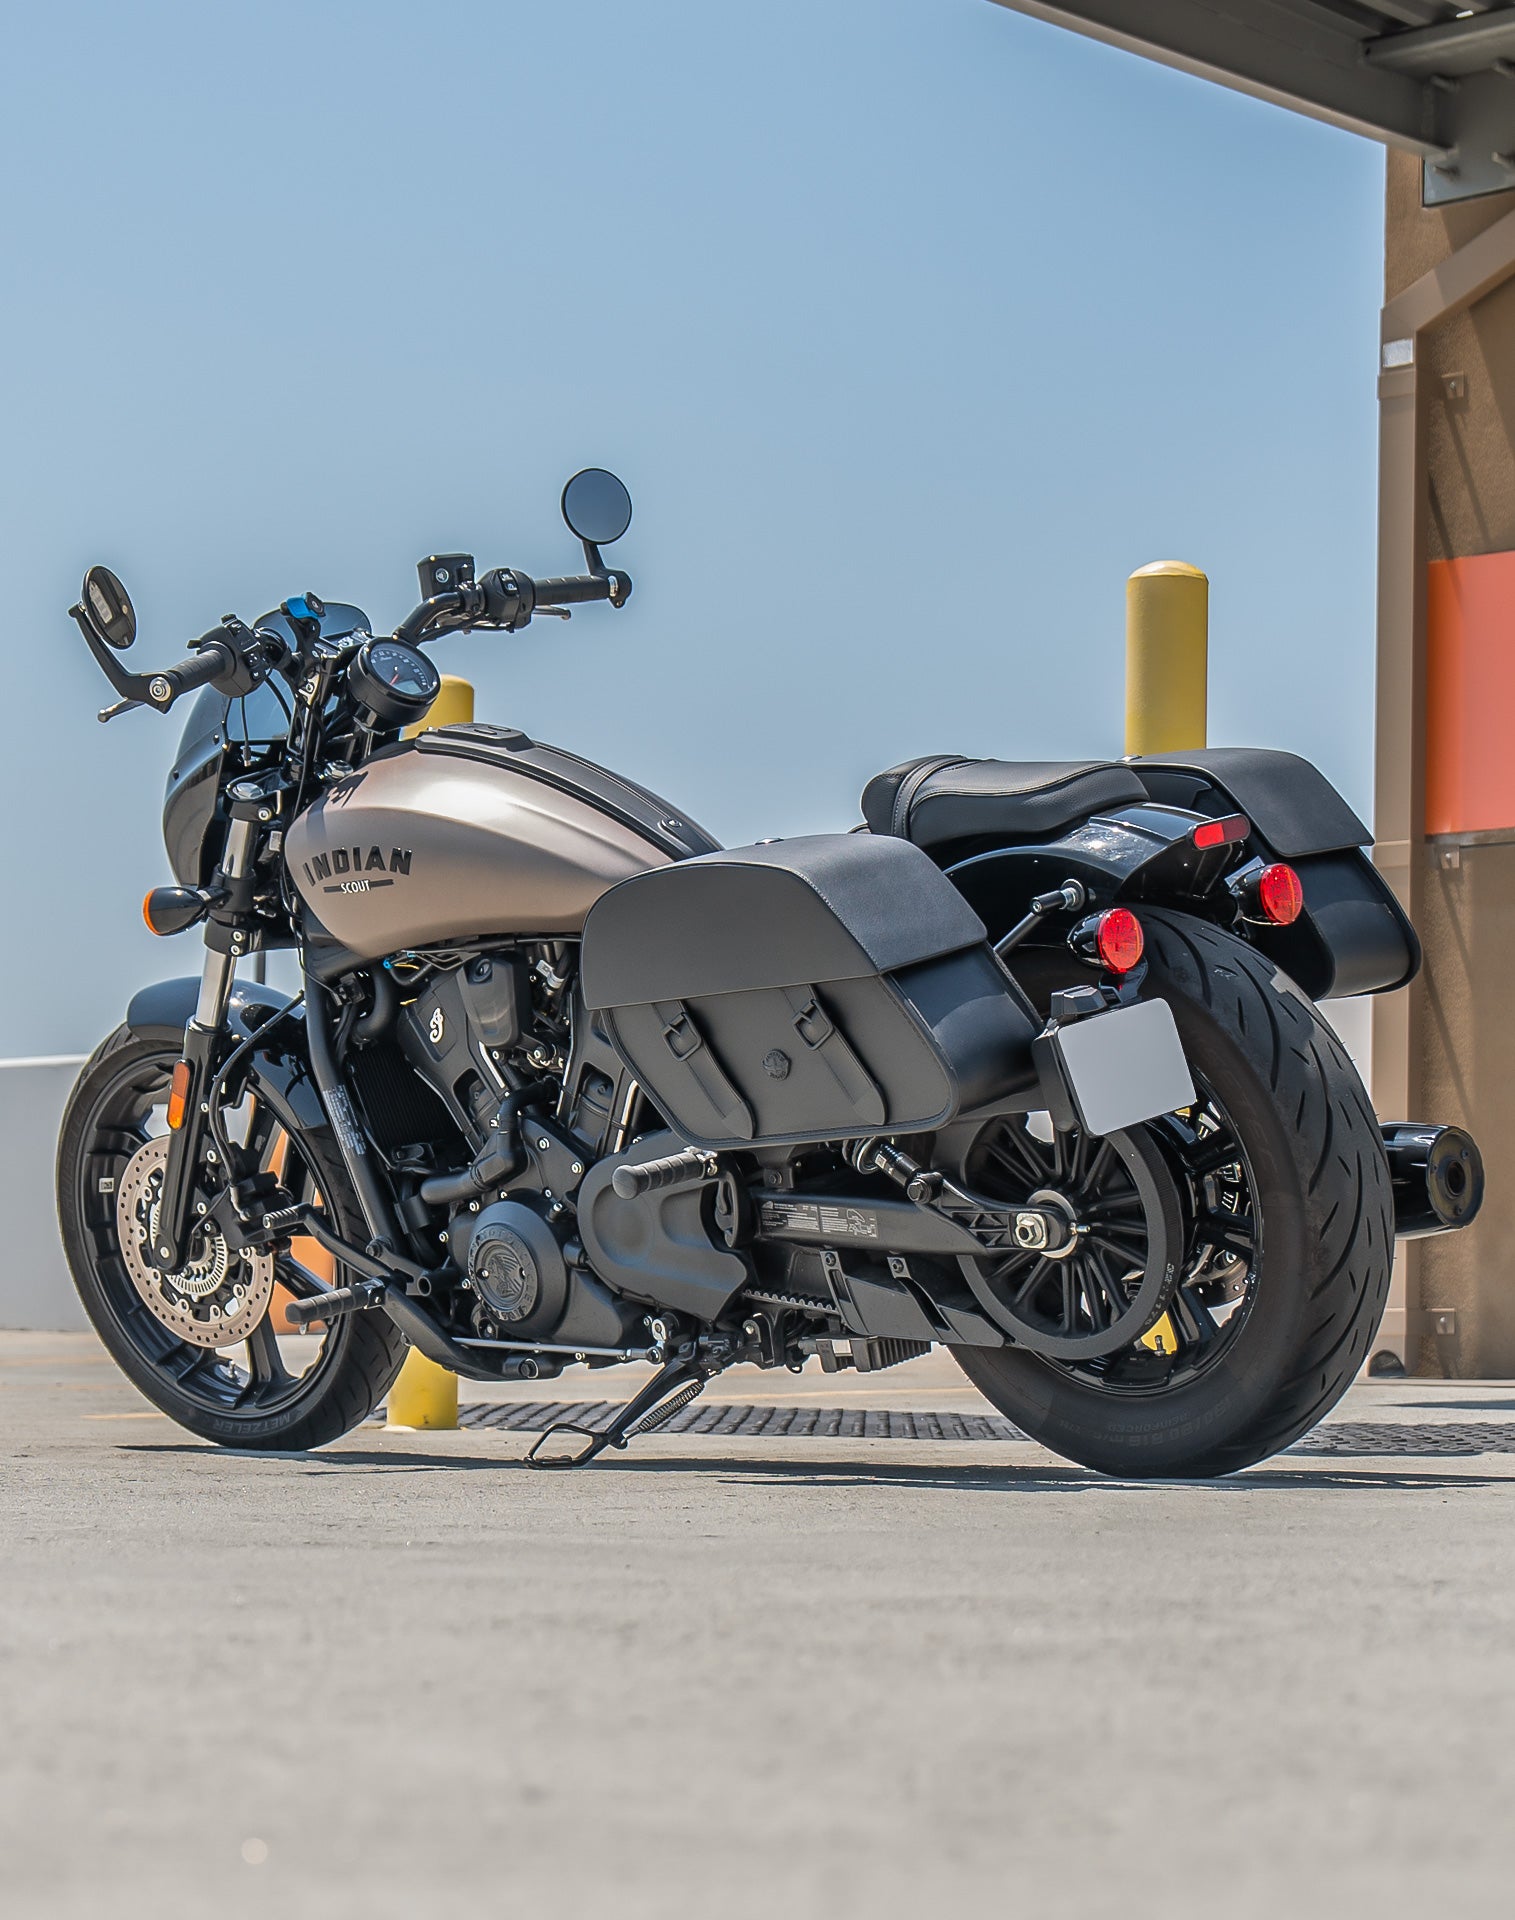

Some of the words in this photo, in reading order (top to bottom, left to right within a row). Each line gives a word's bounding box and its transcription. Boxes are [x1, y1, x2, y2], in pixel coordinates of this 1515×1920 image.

[303, 846, 413, 886] INDIAN
[340, 879, 371, 894] SCOUT
[213, 1413, 290, 1434] METZELER
